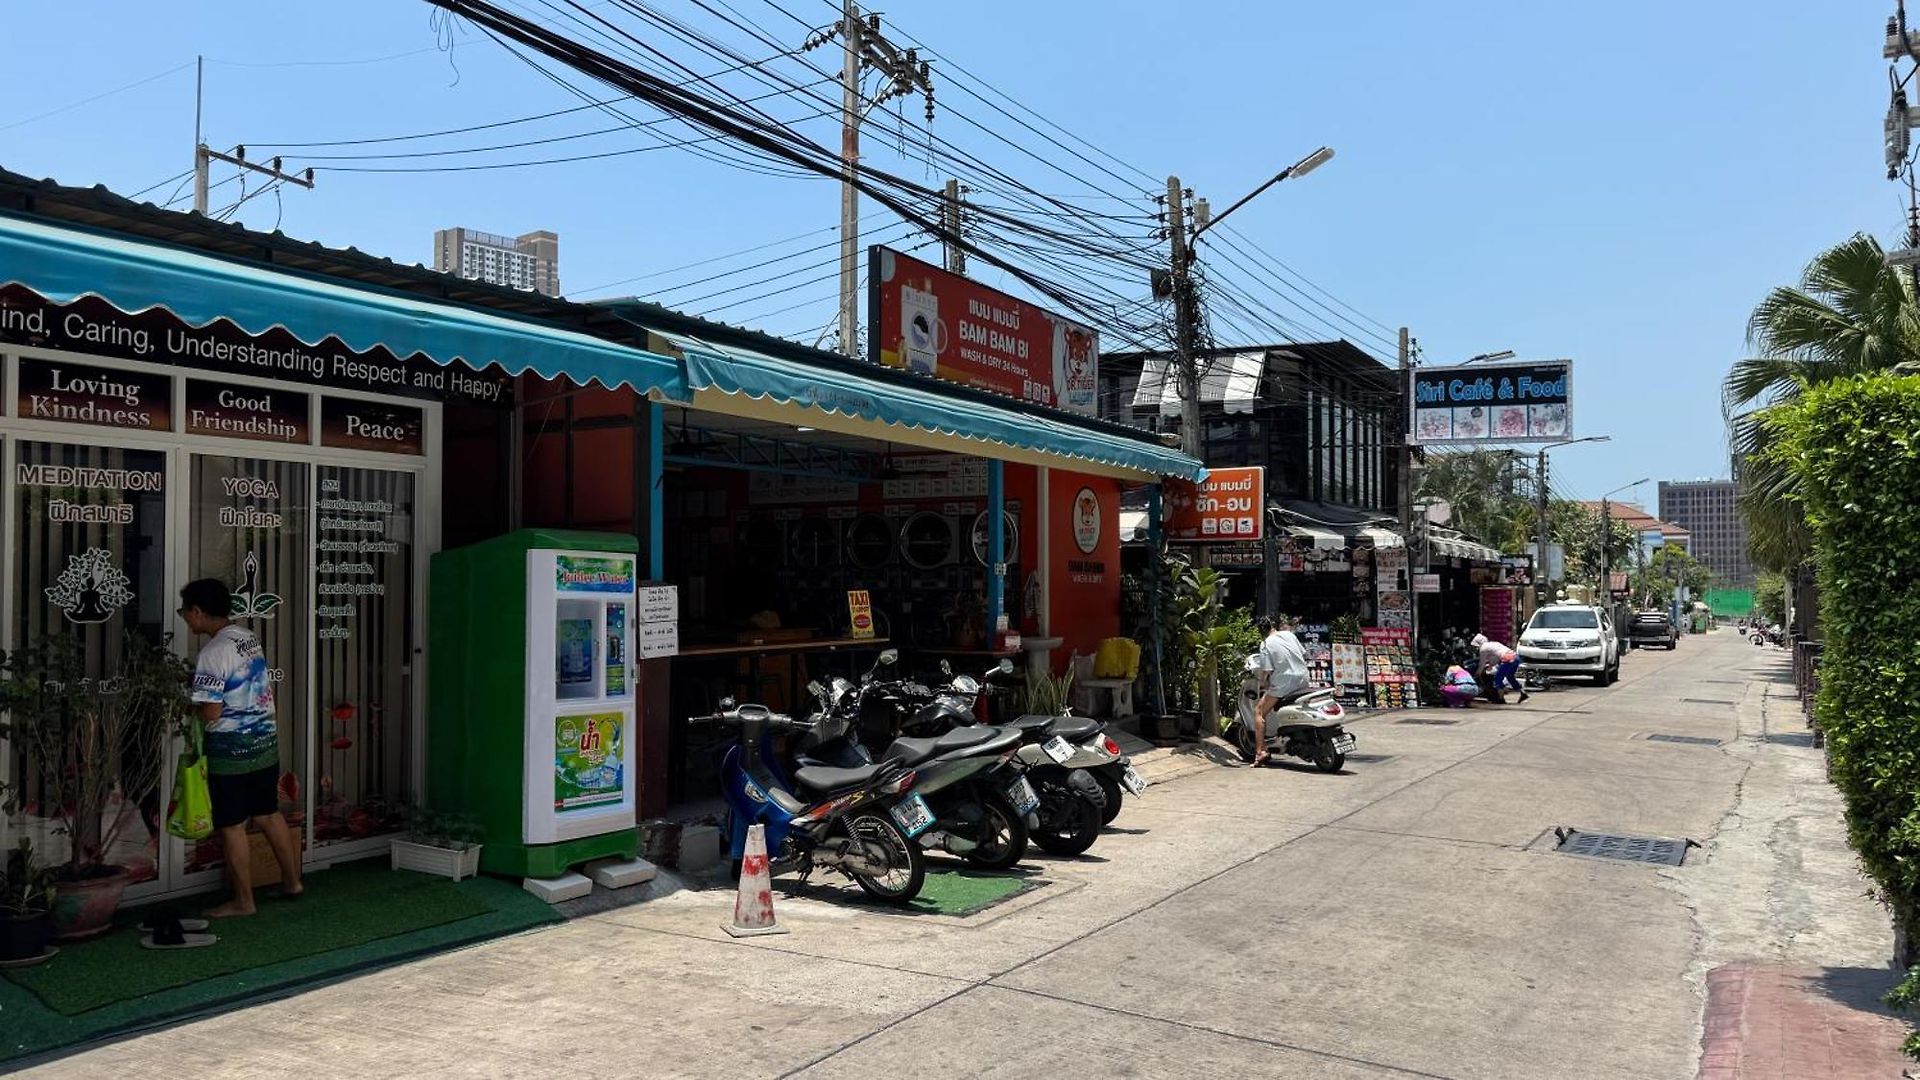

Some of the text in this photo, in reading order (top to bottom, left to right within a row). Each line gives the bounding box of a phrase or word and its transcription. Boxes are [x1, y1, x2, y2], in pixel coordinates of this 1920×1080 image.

[959, 319, 1029, 361] BAM BAM BI
[64, 312, 156, 353] Caring,
[167, 327, 325, 378] Understanding
[333, 355, 407, 386] Respect
[413, 368, 444, 390] and
[451, 370, 501, 402] Happy
[960, 347, 982, 364] WASH
[987, 355, 1001, 370] DRY
[1002, 359, 1011, 373] 24
[50, 370, 140, 405] Loving
[218, 390, 272, 413] Good
[1416, 374, 1567, 404] Siri Café & Food
[31, 395, 151, 427] Kindness
[191, 410, 297, 441] Friendship
[345, 415, 405, 441] Peace
[18, 465, 162, 491] MEDITATION
[222, 477, 279, 499] YOGA
